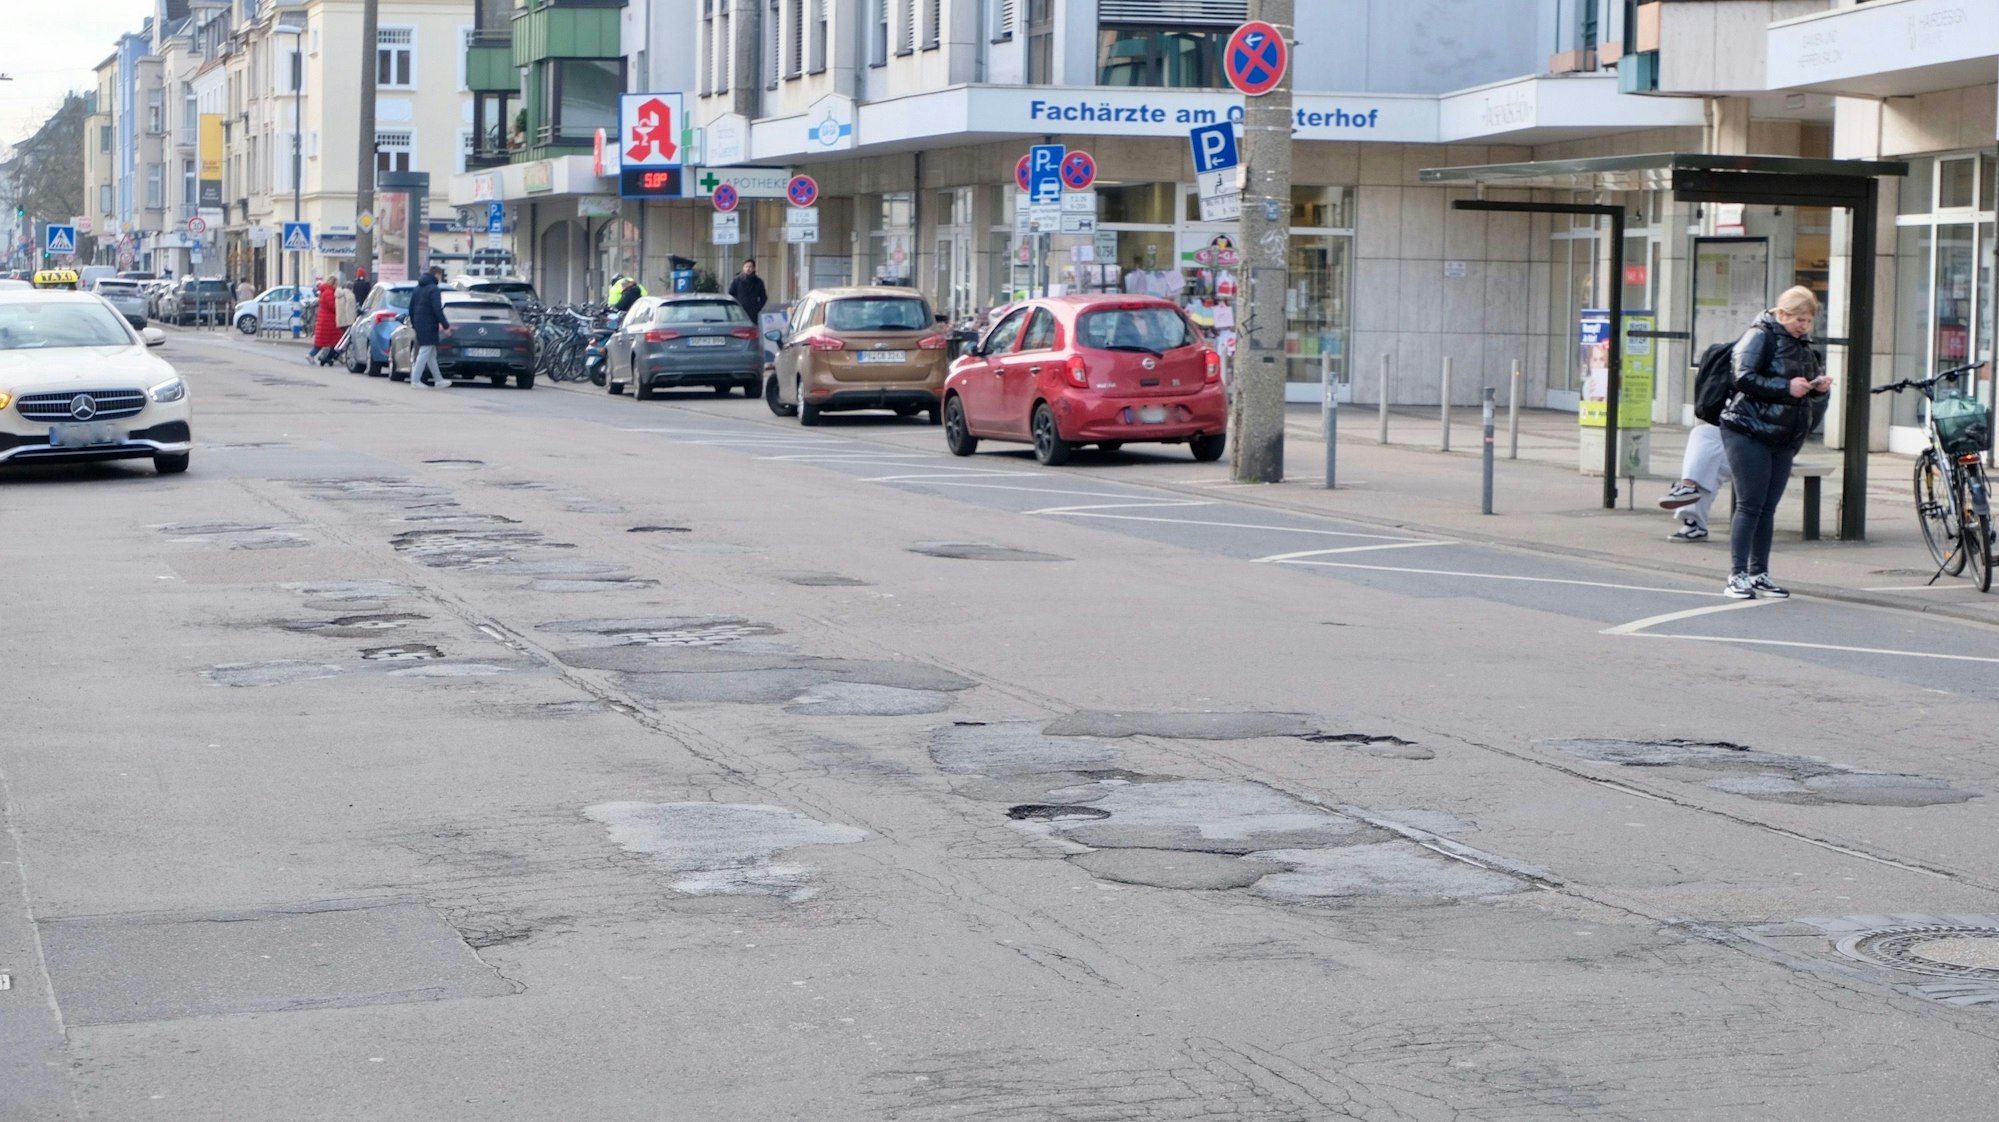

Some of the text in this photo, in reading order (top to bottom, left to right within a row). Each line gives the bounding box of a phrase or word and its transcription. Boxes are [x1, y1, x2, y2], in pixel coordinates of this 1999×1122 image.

[1031, 101, 1165, 122] Fachärzte
[1176, 108, 1216, 123] am
[726, 177, 788, 189] APOTHEKE
[42, 272, 73, 281] TAXI
